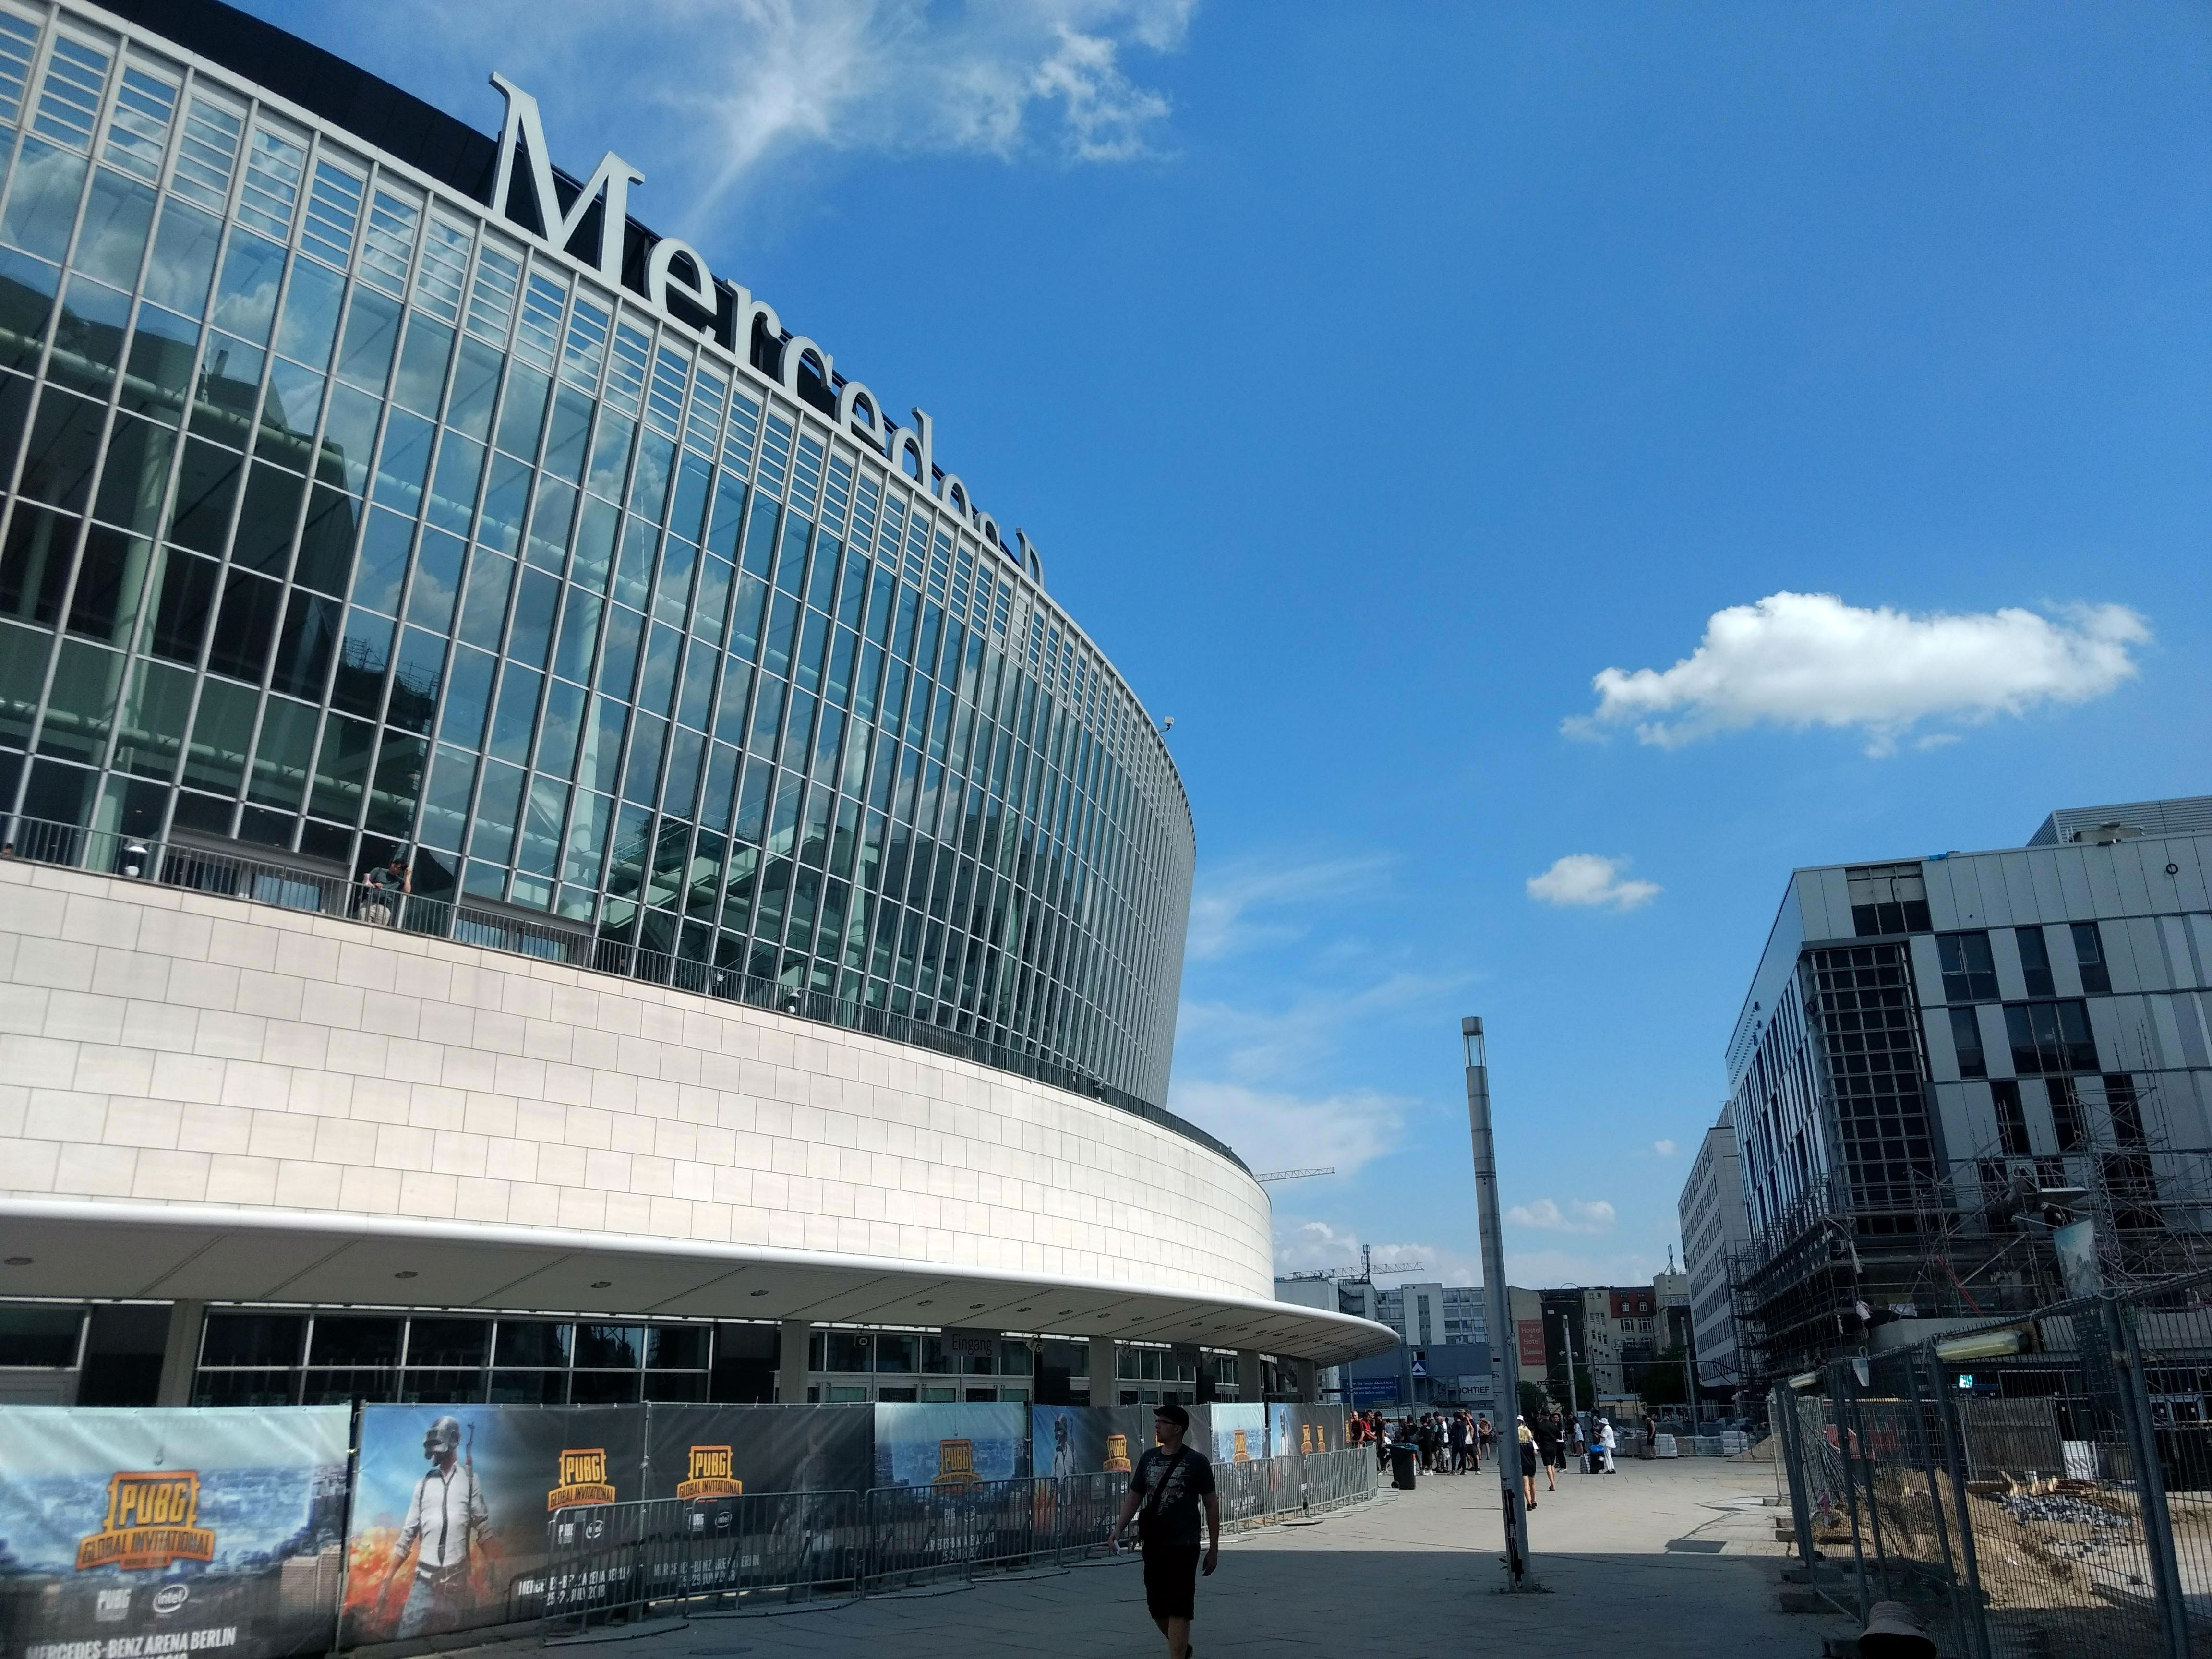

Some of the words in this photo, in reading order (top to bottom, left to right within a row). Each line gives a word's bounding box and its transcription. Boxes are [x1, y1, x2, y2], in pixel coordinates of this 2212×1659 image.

[489, 71, 1045, 591] Mercede
[952, 1334, 992, 1356] Eingang
[944, 1447, 969, 1471] PUBG
[1109, 1439, 1124, 1456] PUBG
[566, 1455, 600, 1483] PUBG
[695, 1452, 726, 1477] PUBG
[550, 1488, 573, 1507] GLOBAL
[575, 1486, 613, 1503] INVITATIONAL
[679, 1481, 700, 1498] GLOBAL
[702, 1479, 740, 1495] INVITATIONAL
[119, 1482, 187, 1526] PUBG
[689, 1513, 704, 1526] UBG
[81, 1533, 126, 1563] GLOBAL
[653, 1559, 712, 1576] MREE-BNZ
[739, 1554, 759, 1568] ERIN
[97, 1588, 132, 1610] PUBG
[144, 1633, 189, 1654] ARENA
[189, 1626, 238, 1650] BERLIN
